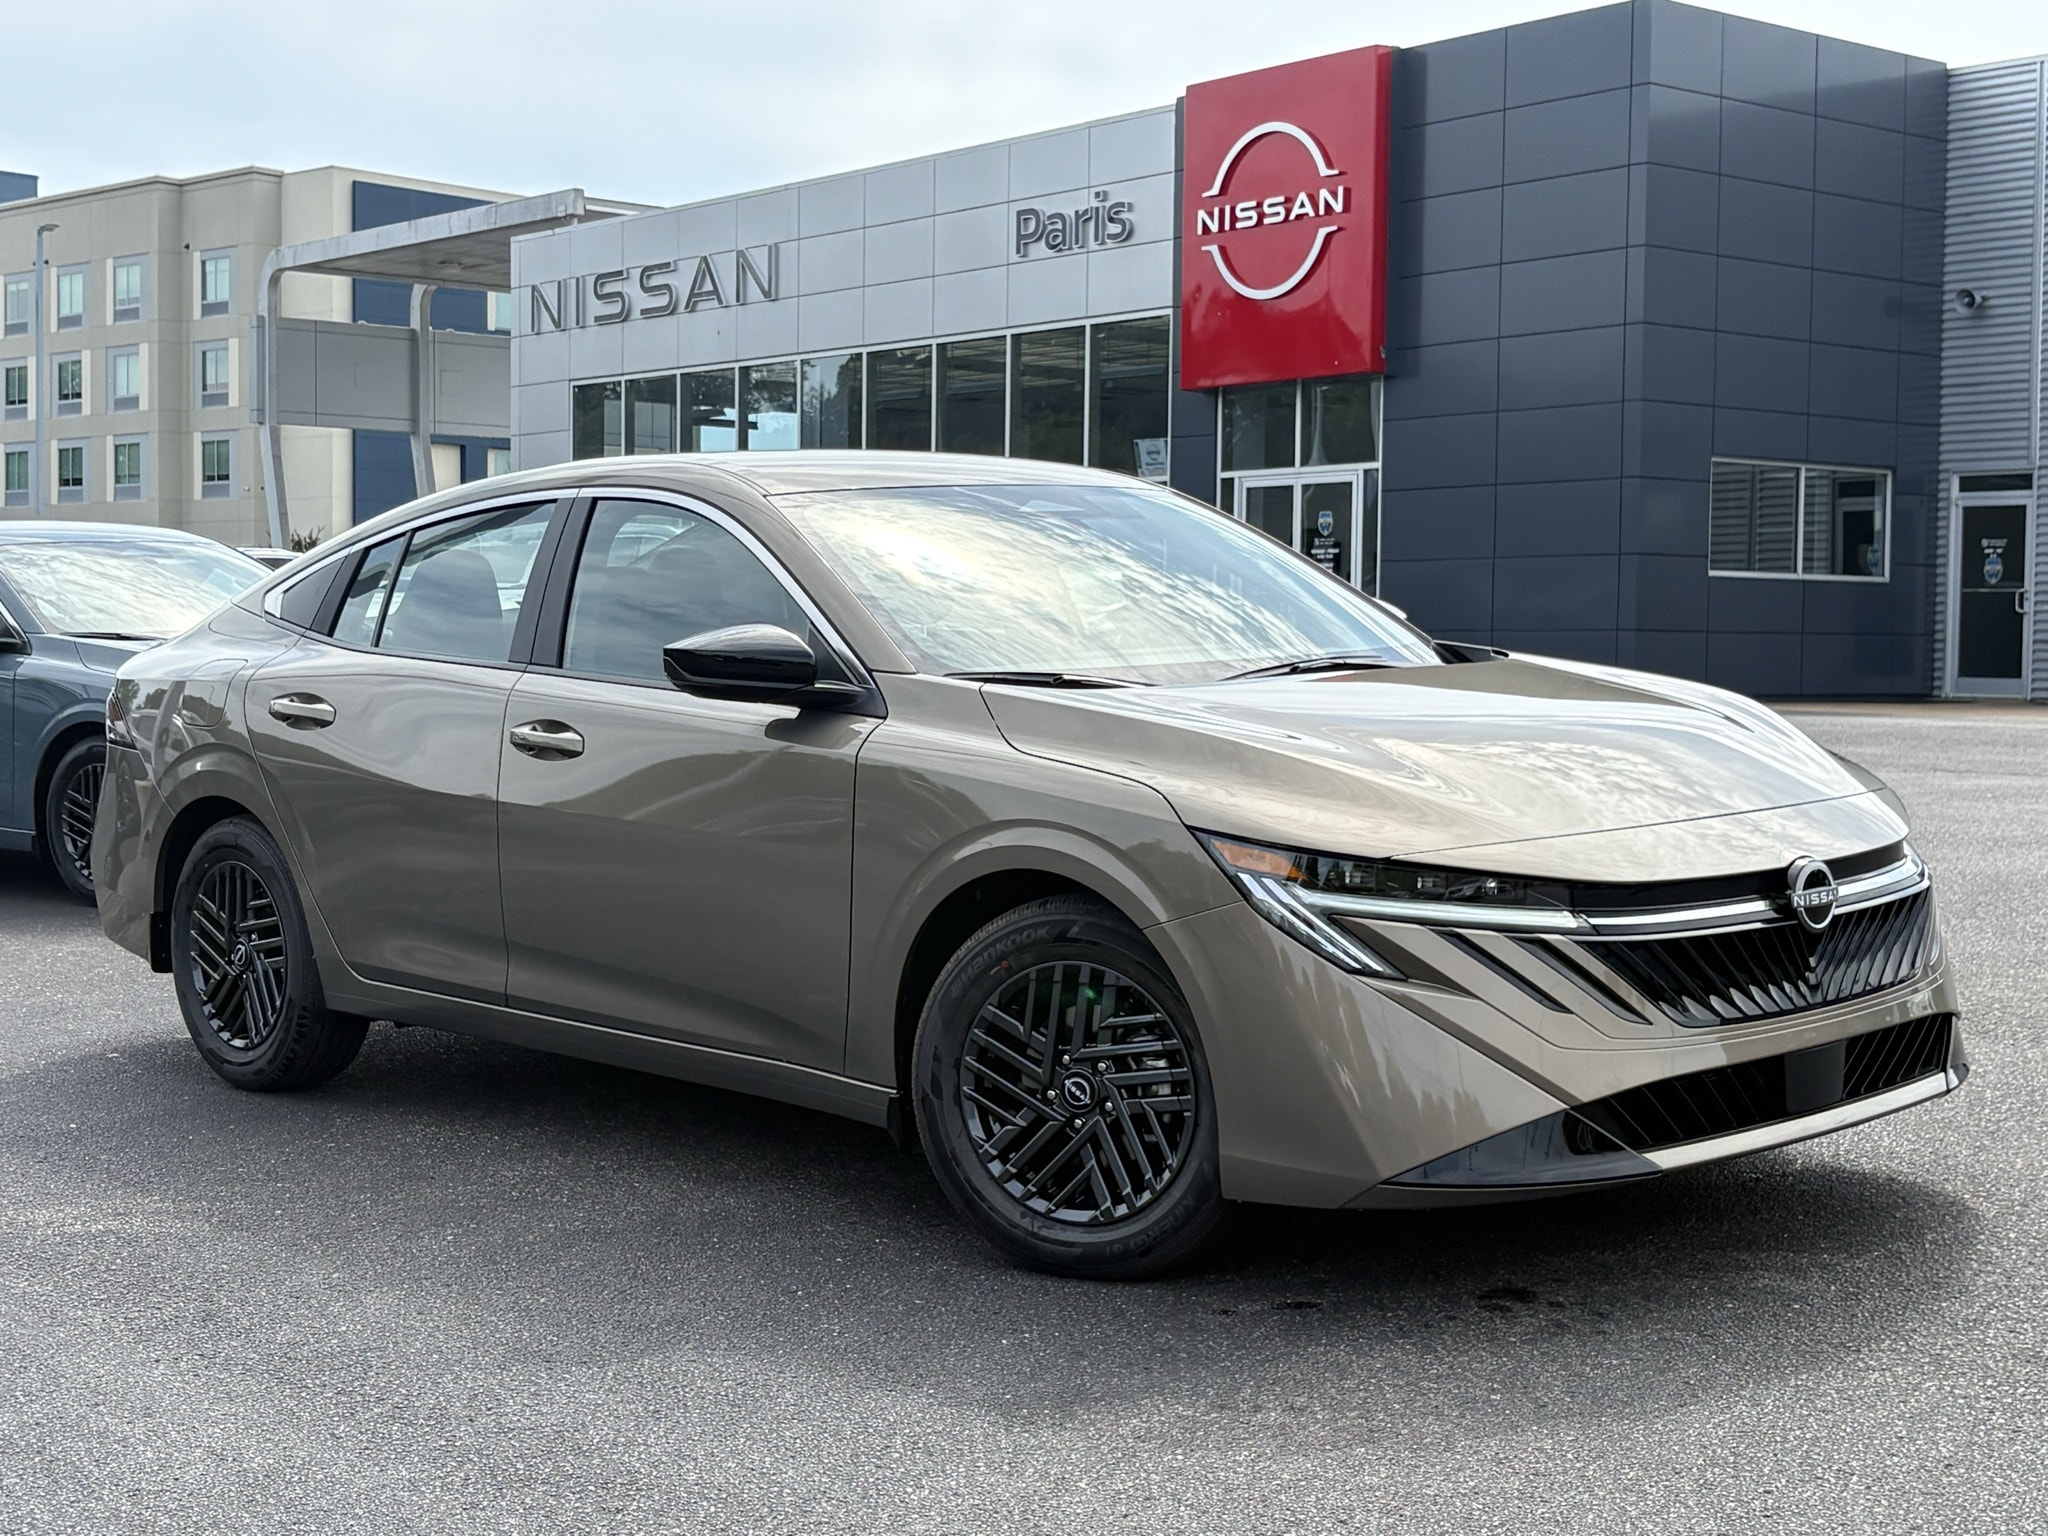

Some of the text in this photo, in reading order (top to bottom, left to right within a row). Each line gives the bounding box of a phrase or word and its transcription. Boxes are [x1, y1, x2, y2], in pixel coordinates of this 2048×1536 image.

[1016, 190, 1133, 257] Paris
[1197, 185, 1344, 235] NISSAN
[531, 242, 777, 334] NISSAN
